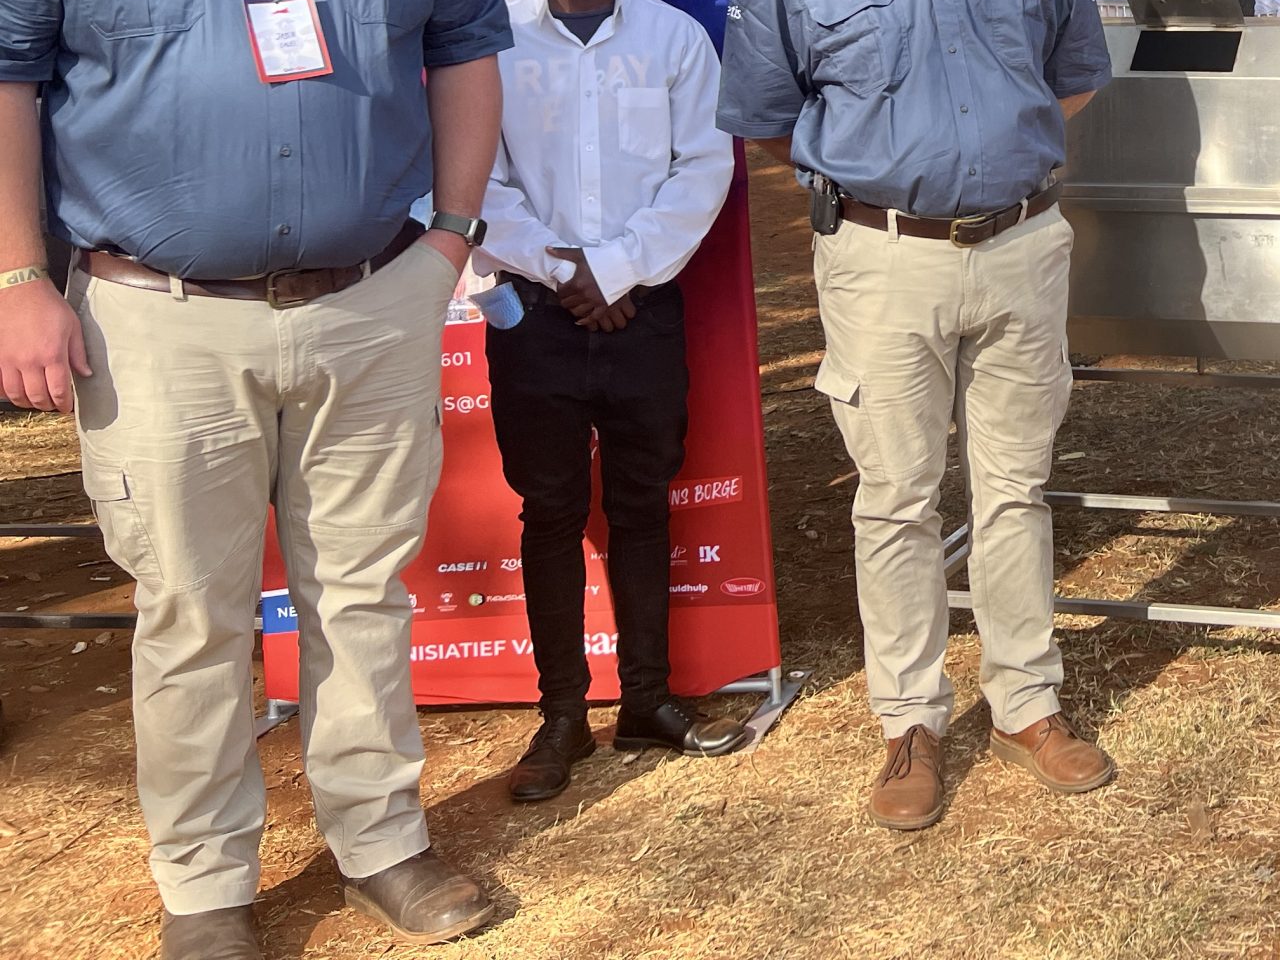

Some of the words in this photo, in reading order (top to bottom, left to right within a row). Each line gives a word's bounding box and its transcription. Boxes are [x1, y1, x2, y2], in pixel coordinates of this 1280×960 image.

[7, 268, 40, 285] VIP
[441, 351, 472, 367] 601
[444, 394, 489, 413] S@G
[669, 488, 689, 505] NS
[694, 477, 740, 503] BORGE
[669, 545, 687, 559] dP
[438, 562, 474, 572] CASE
[500, 558, 522, 571] zoe
[669, 584, 709, 594] uldhulp
[277, 607, 298, 619] NE
[410, 640, 506, 661] ISIATIEF
